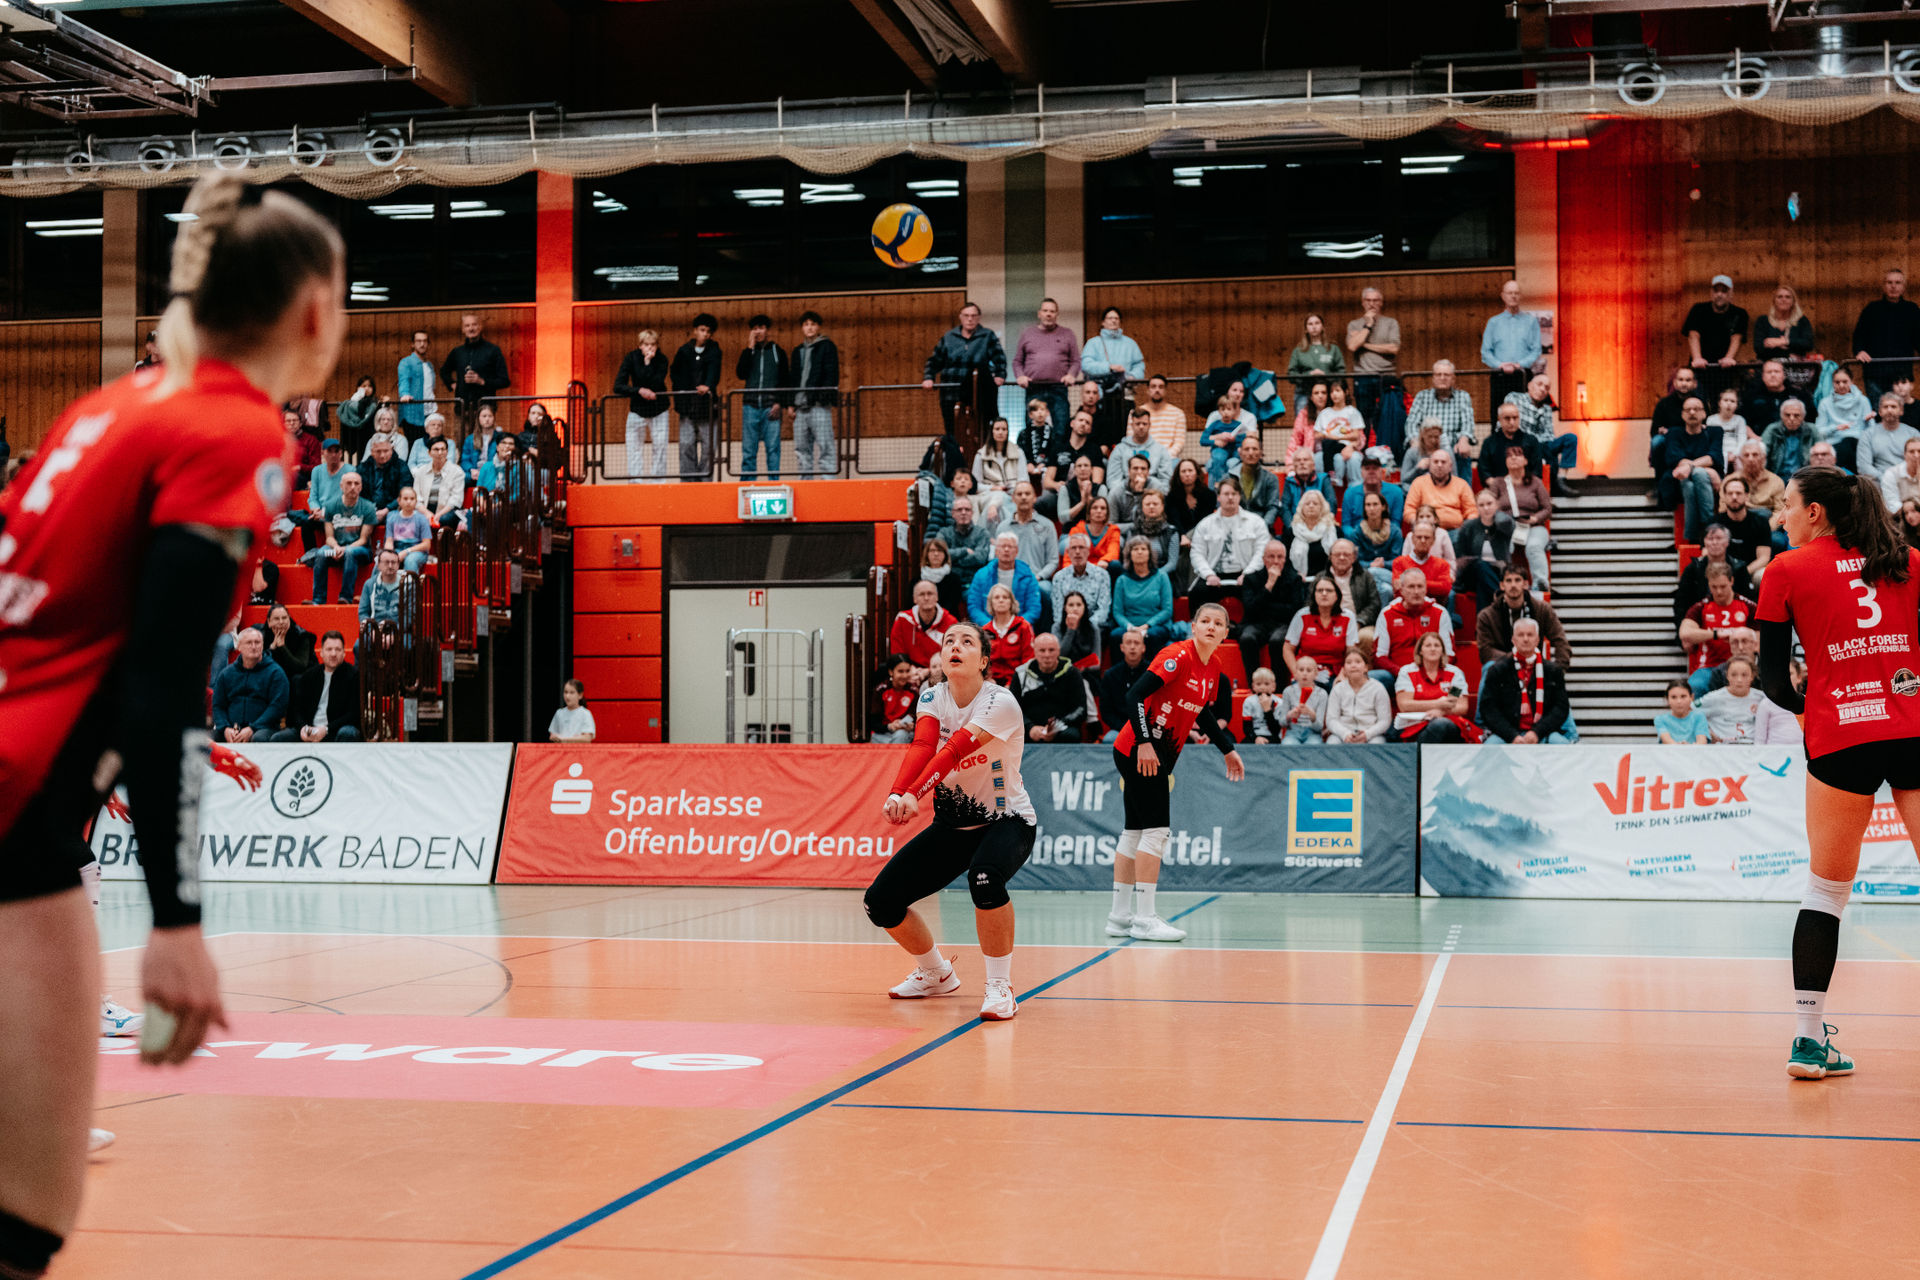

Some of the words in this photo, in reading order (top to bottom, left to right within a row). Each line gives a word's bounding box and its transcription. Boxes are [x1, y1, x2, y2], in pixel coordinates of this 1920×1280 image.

[1849, 579, 1882, 628] 3
[1722, 610, 1730, 626] 2
[1828, 637, 1867, 655] BLACK
[1869, 634, 1909, 646] FOREST
[1831, 648, 1867, 662] VOLLEYS
[1868, 645, 1910, 655] OFFENBURG
[1202, 679, 1206, 699] 1
[1051, 771, 1111, 811] Wir
[1593, 753, 1749, 815] Vitrex
[608, 789, 762, 821] Sparkasse
[1649, 817, 1670, 828] DEN
[338, 836, 486, 871] BADEN
[604, 827, 894, 862] Offenburg/Ortenau
[1294, 837, 1355, 849] EDEKA
[1284, 856, 1363, 868] Südwest
